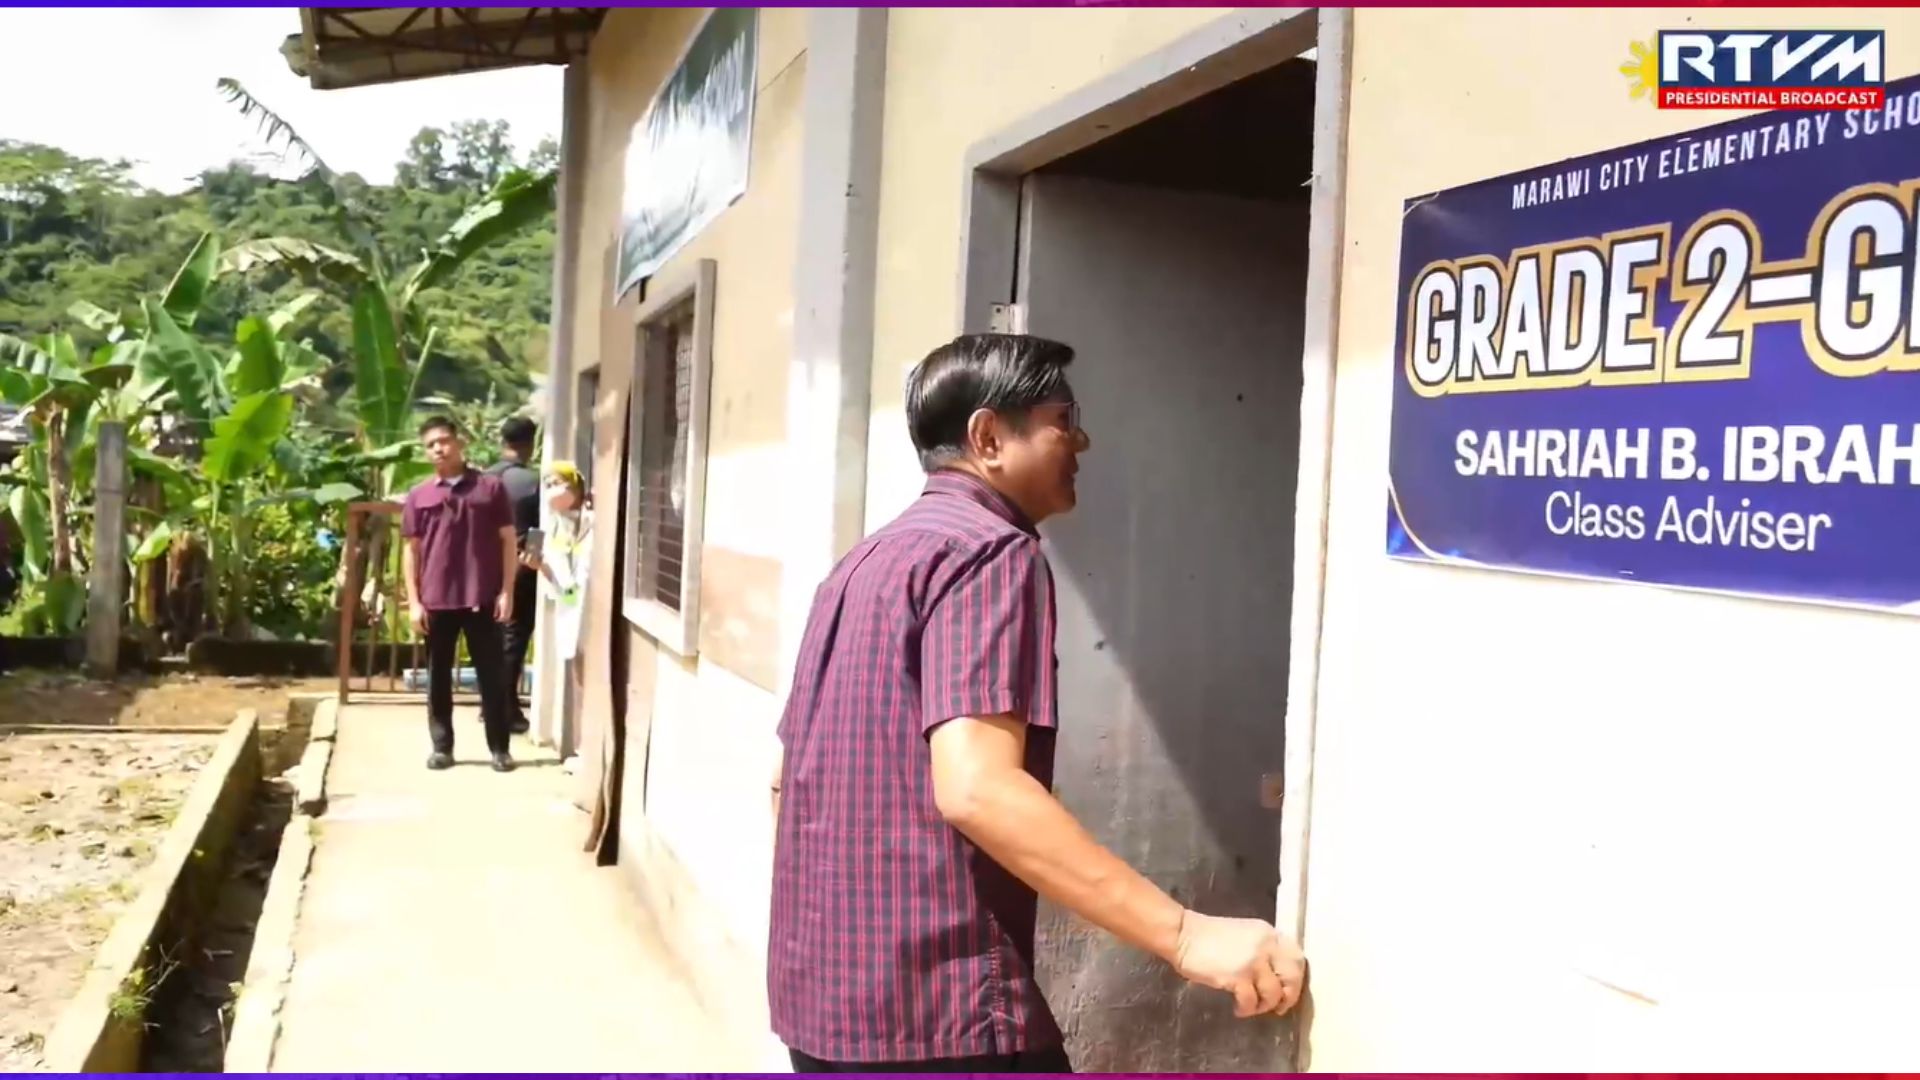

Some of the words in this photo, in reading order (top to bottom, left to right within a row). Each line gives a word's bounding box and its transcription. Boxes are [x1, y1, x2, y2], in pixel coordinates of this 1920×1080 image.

[1512, 168, 1590, 210] MARAWI
[1600, 154, 1649, 191] CITY
[1658, 112, 1831, 179] ELEMENTARY
[1411, 234, 1668, 388] GRADE
[1677, 197, 1920, 367] 2-G
[1454, 427, 1650, 479] SAHRIAH
[1660, 427, 1710, 481] B.
[1723, 423, 1920, 485] IBRAH
[1545, 490, 1646, 540] Class
[1655, 495, 1833, 552] Adviser
